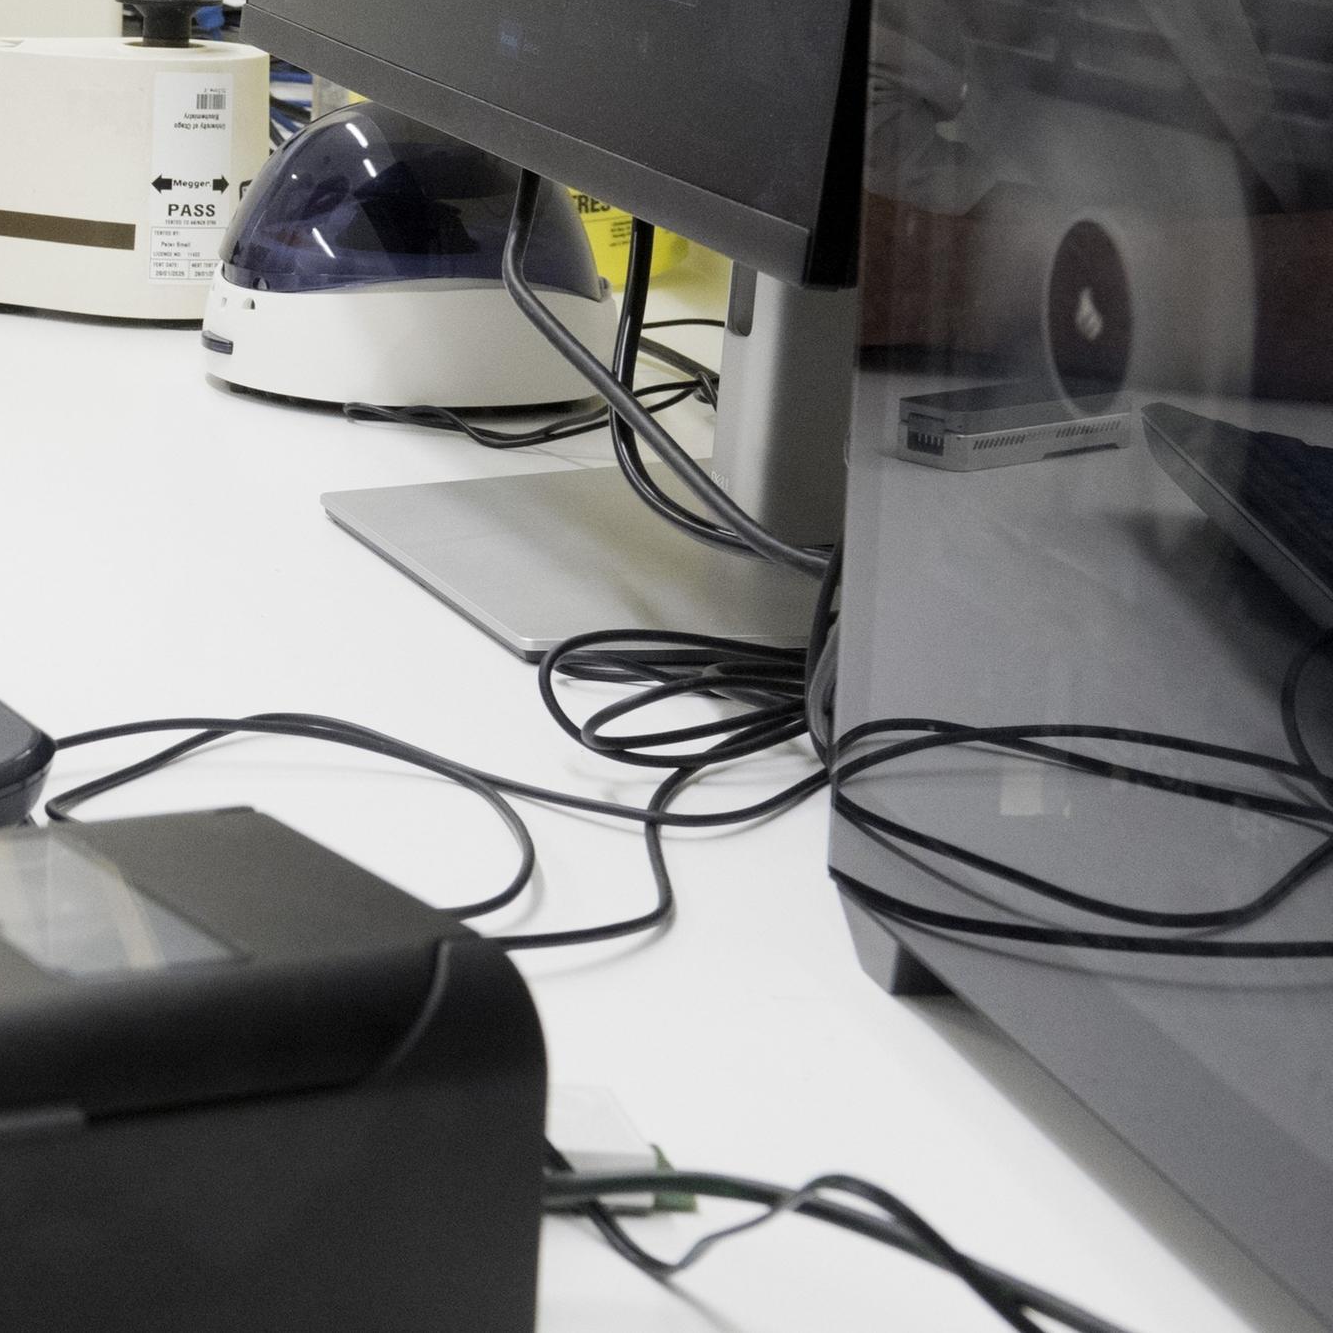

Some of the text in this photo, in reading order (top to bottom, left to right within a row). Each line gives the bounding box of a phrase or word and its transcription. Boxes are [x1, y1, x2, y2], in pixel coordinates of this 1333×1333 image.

[173, 122, 191, 130] Otago
[200, 122, 226, 130] University
[168, 203, 216, 217] PASS
